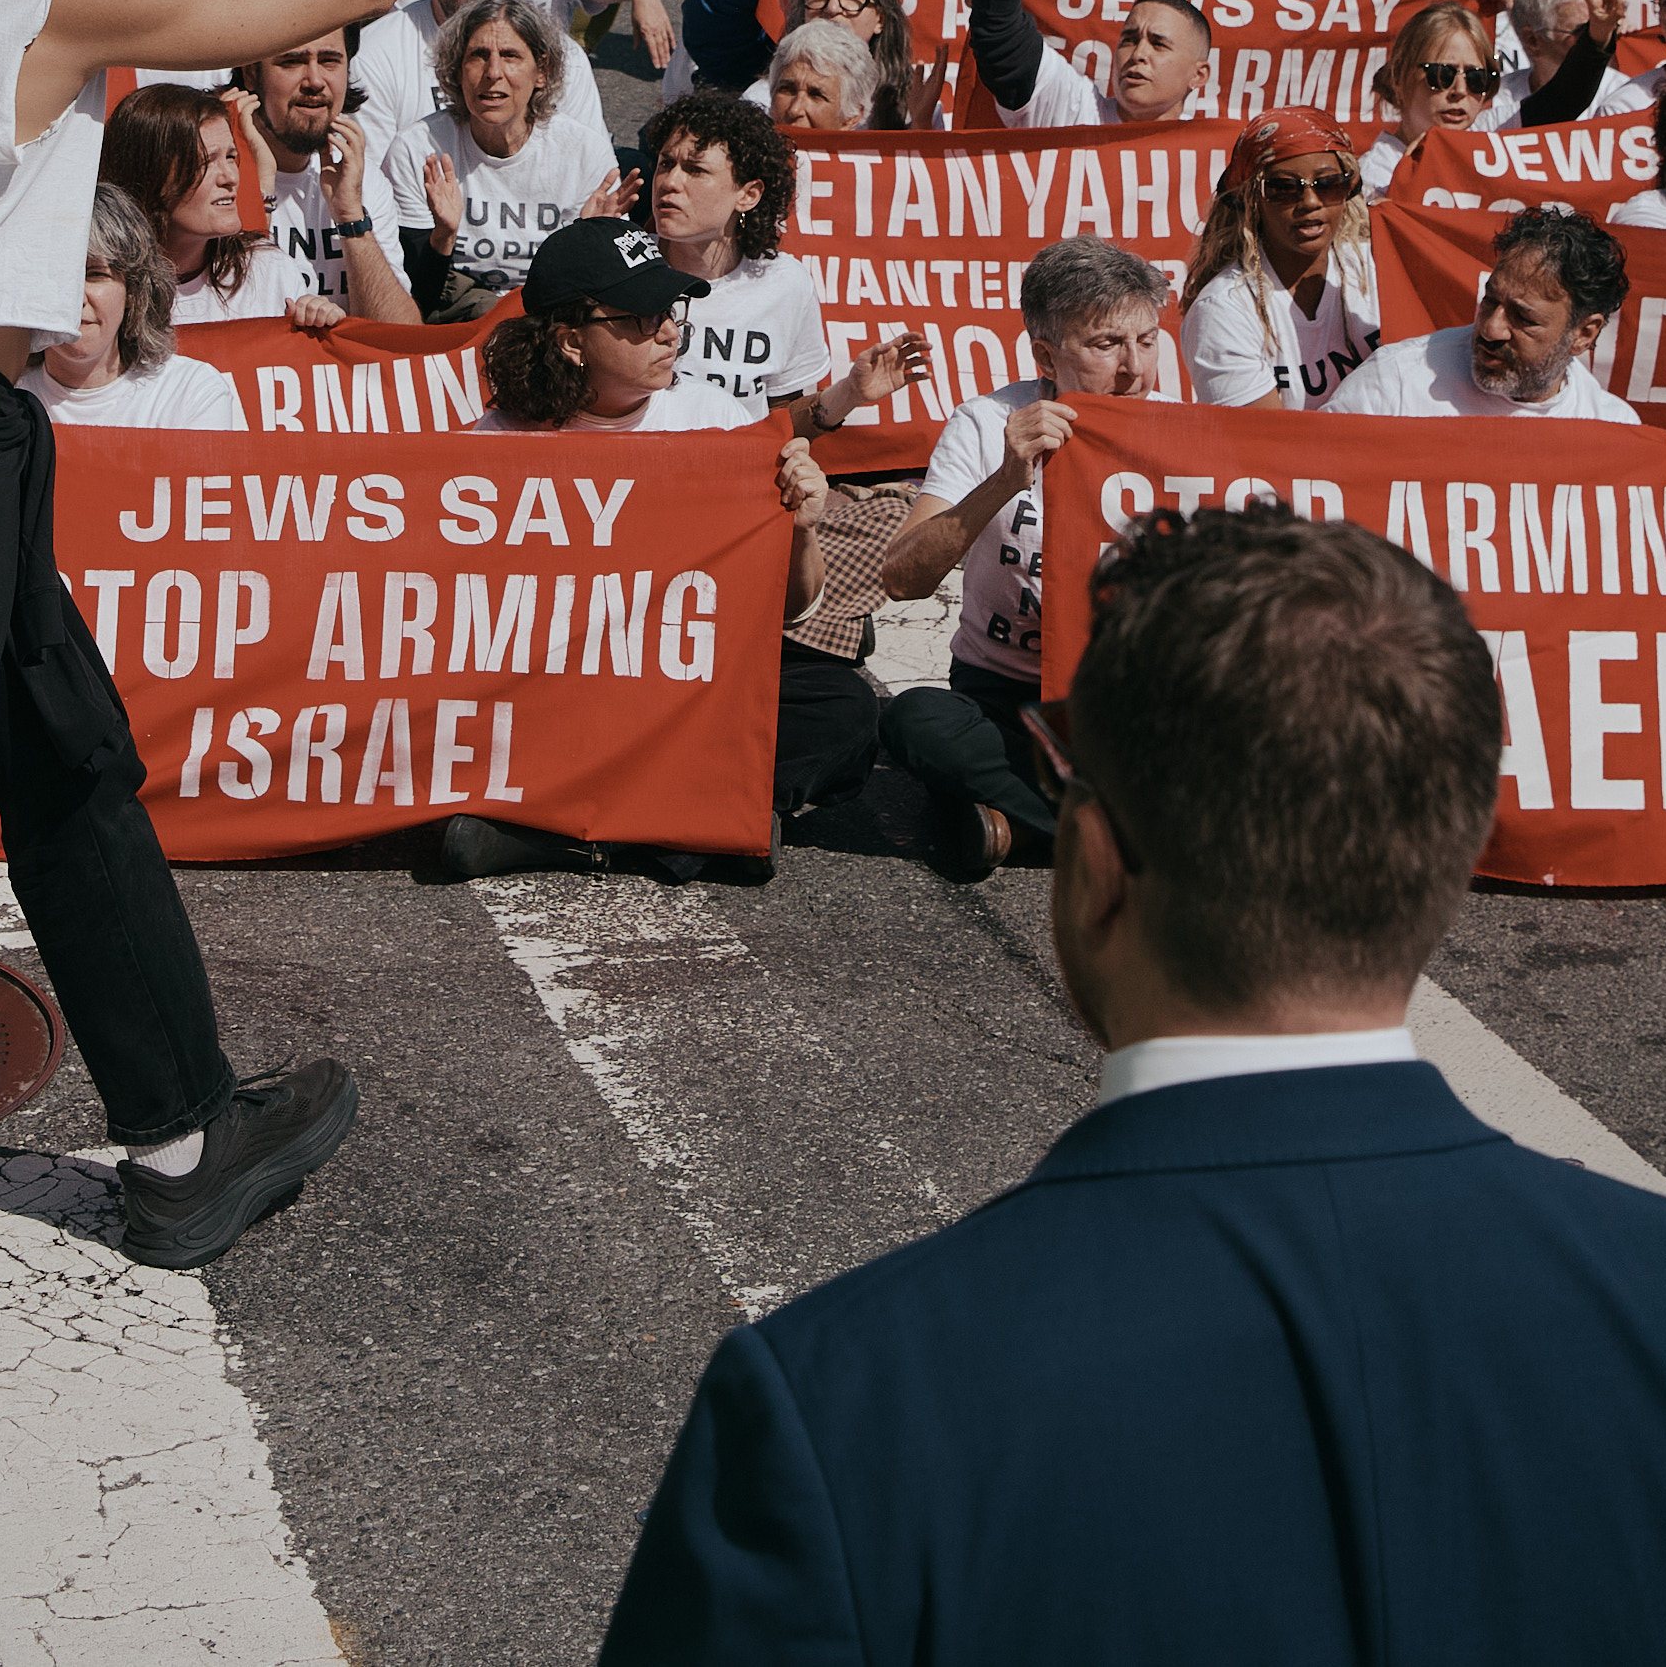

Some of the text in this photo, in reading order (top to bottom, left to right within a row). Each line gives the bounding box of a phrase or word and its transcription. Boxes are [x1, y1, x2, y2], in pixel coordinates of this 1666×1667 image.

[795, 148, 1227, 239] ETANYAHU
[1471, 125, 1660, 183] JEWS
[467, 197, 562, 231] UND
[676, 324, 771, 365] UND
[222, 345, 489, 434] RMIN
[118, 471, 637, 547] JEWS SAY
[57, 567, 719, 684] TOP ARMING
[178, 697, 525, 806] ISRAEL
